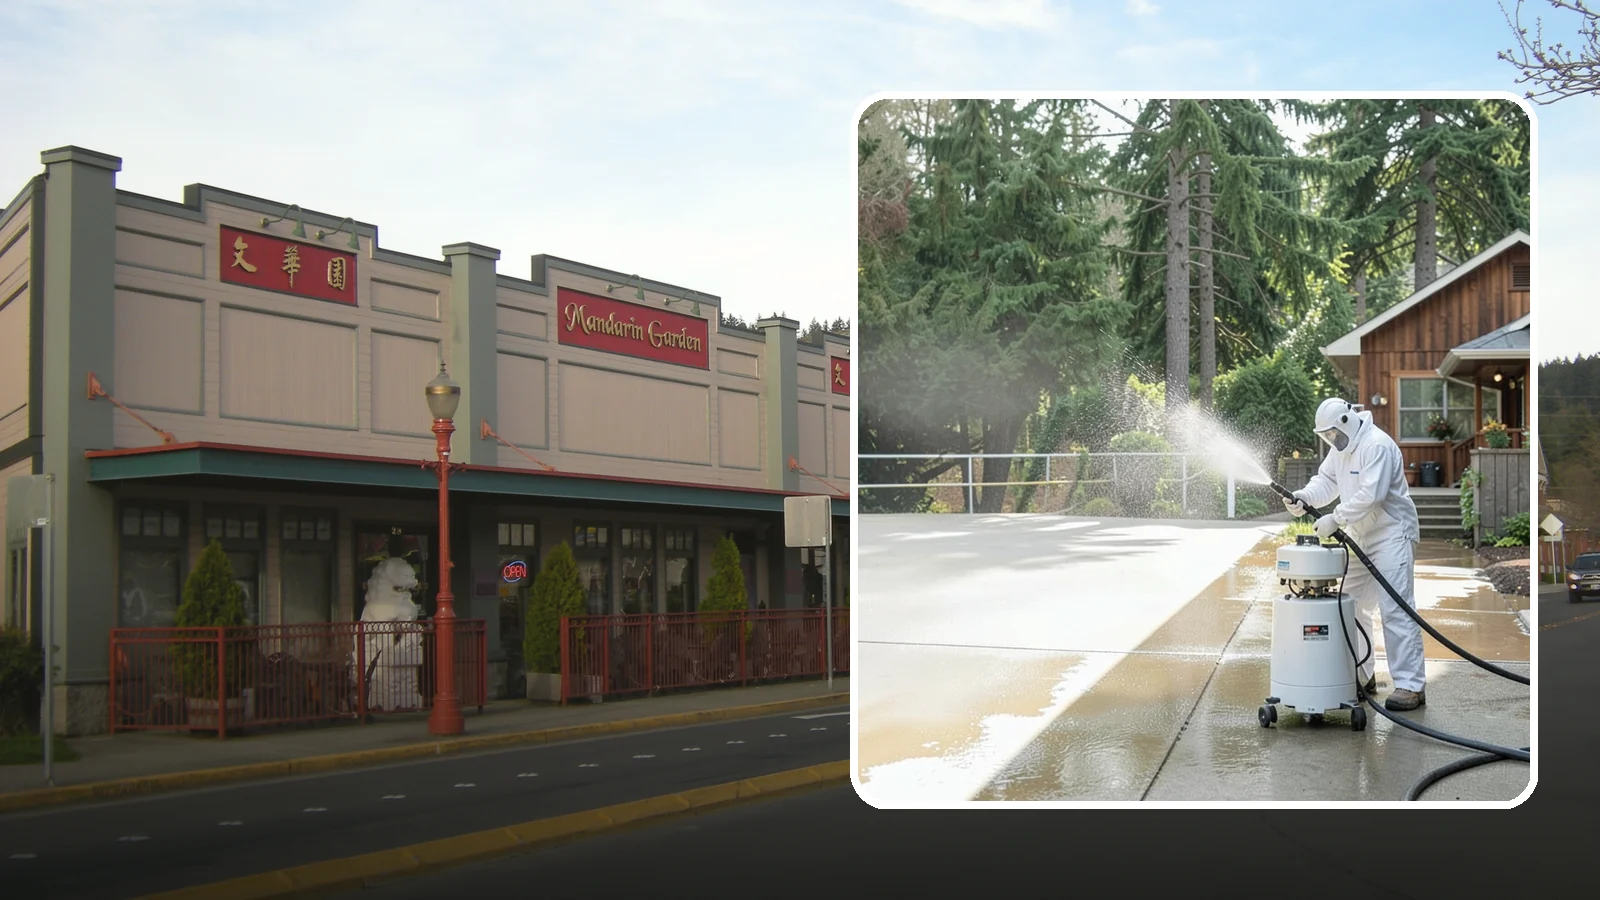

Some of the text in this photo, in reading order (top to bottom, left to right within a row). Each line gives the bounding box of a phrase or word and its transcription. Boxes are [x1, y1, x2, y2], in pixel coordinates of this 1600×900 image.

[231, 236, 346, 290] 文華園
[564, 302, 701, 352] Mandarin Garden
[503, 565, 527, 579] OPEN
